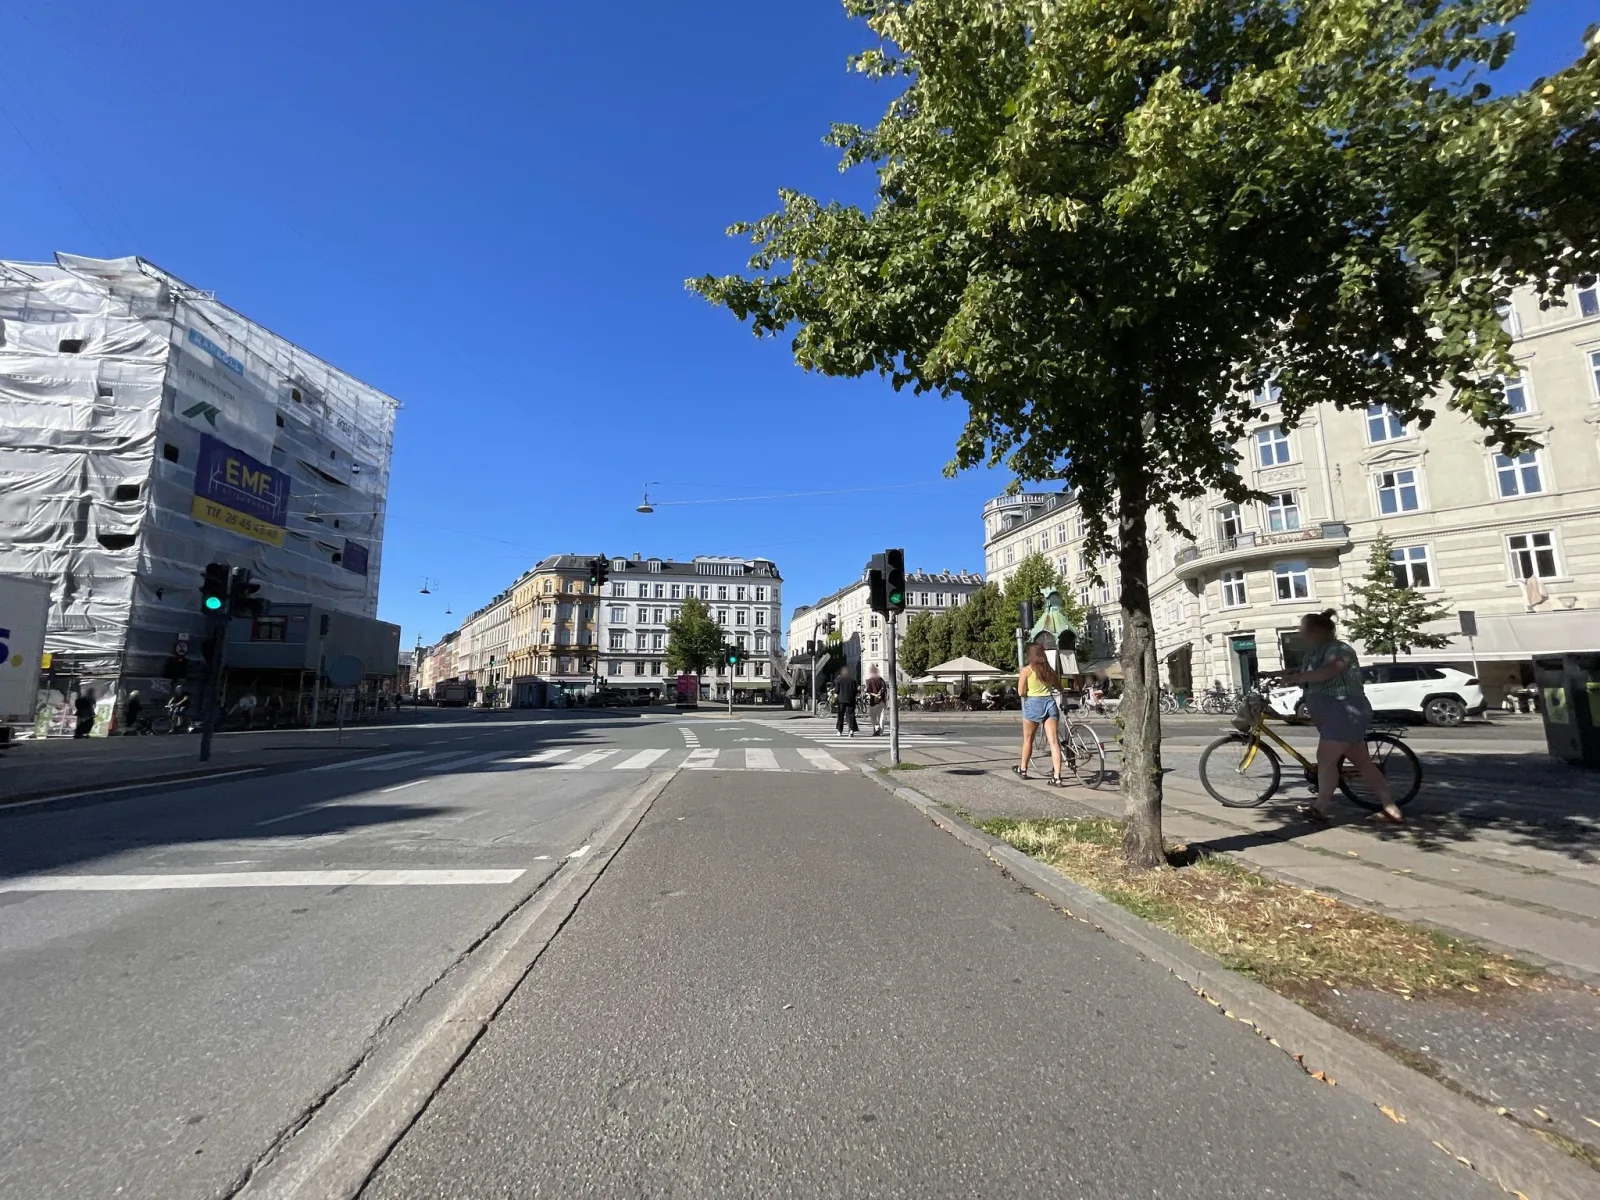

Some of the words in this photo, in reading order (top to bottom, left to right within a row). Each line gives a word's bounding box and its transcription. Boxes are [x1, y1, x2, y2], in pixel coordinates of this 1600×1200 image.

[225, 457, 272, 496] EMF
[206, 504, 222, 520] Tlf.
[225, 512, 238, 525] 25
[239, 518, 252, 530] 45
